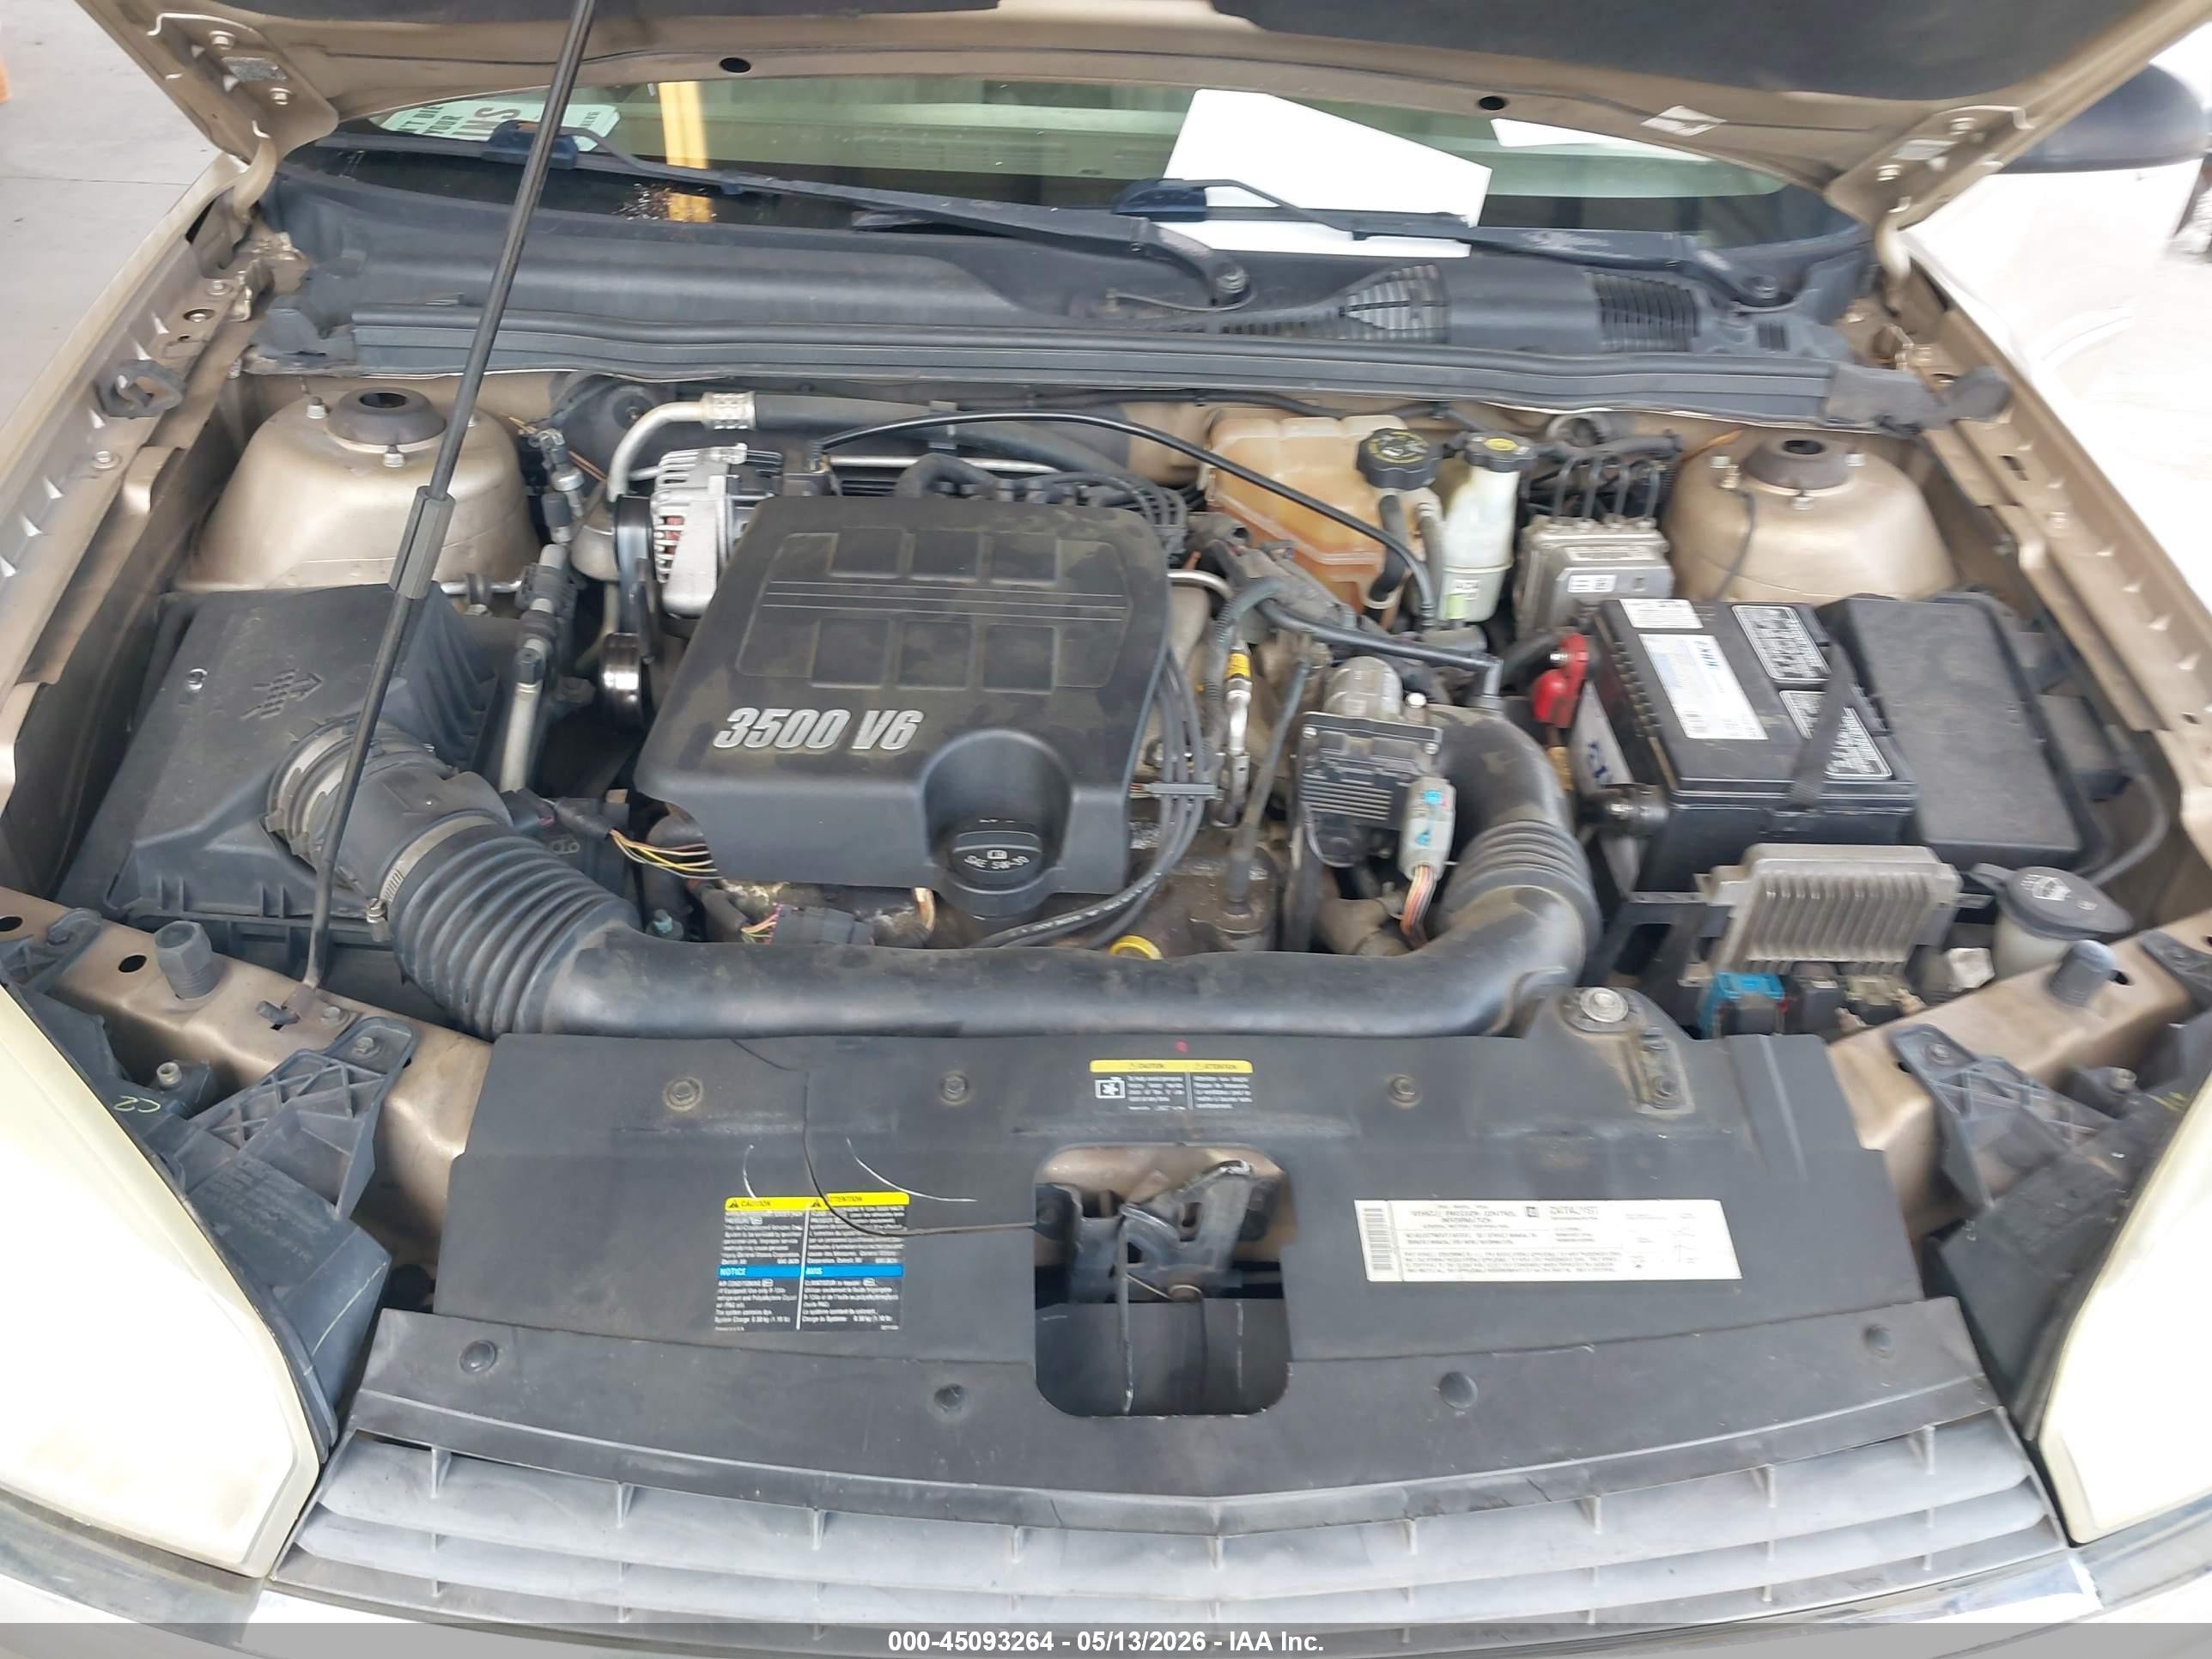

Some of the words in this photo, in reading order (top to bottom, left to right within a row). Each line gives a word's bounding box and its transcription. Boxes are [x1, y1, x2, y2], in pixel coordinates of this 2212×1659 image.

[422, 116, 463, 135] YOUR
[713, 708, 852, 749] 3500
[851, 709, 925, 750] V6
